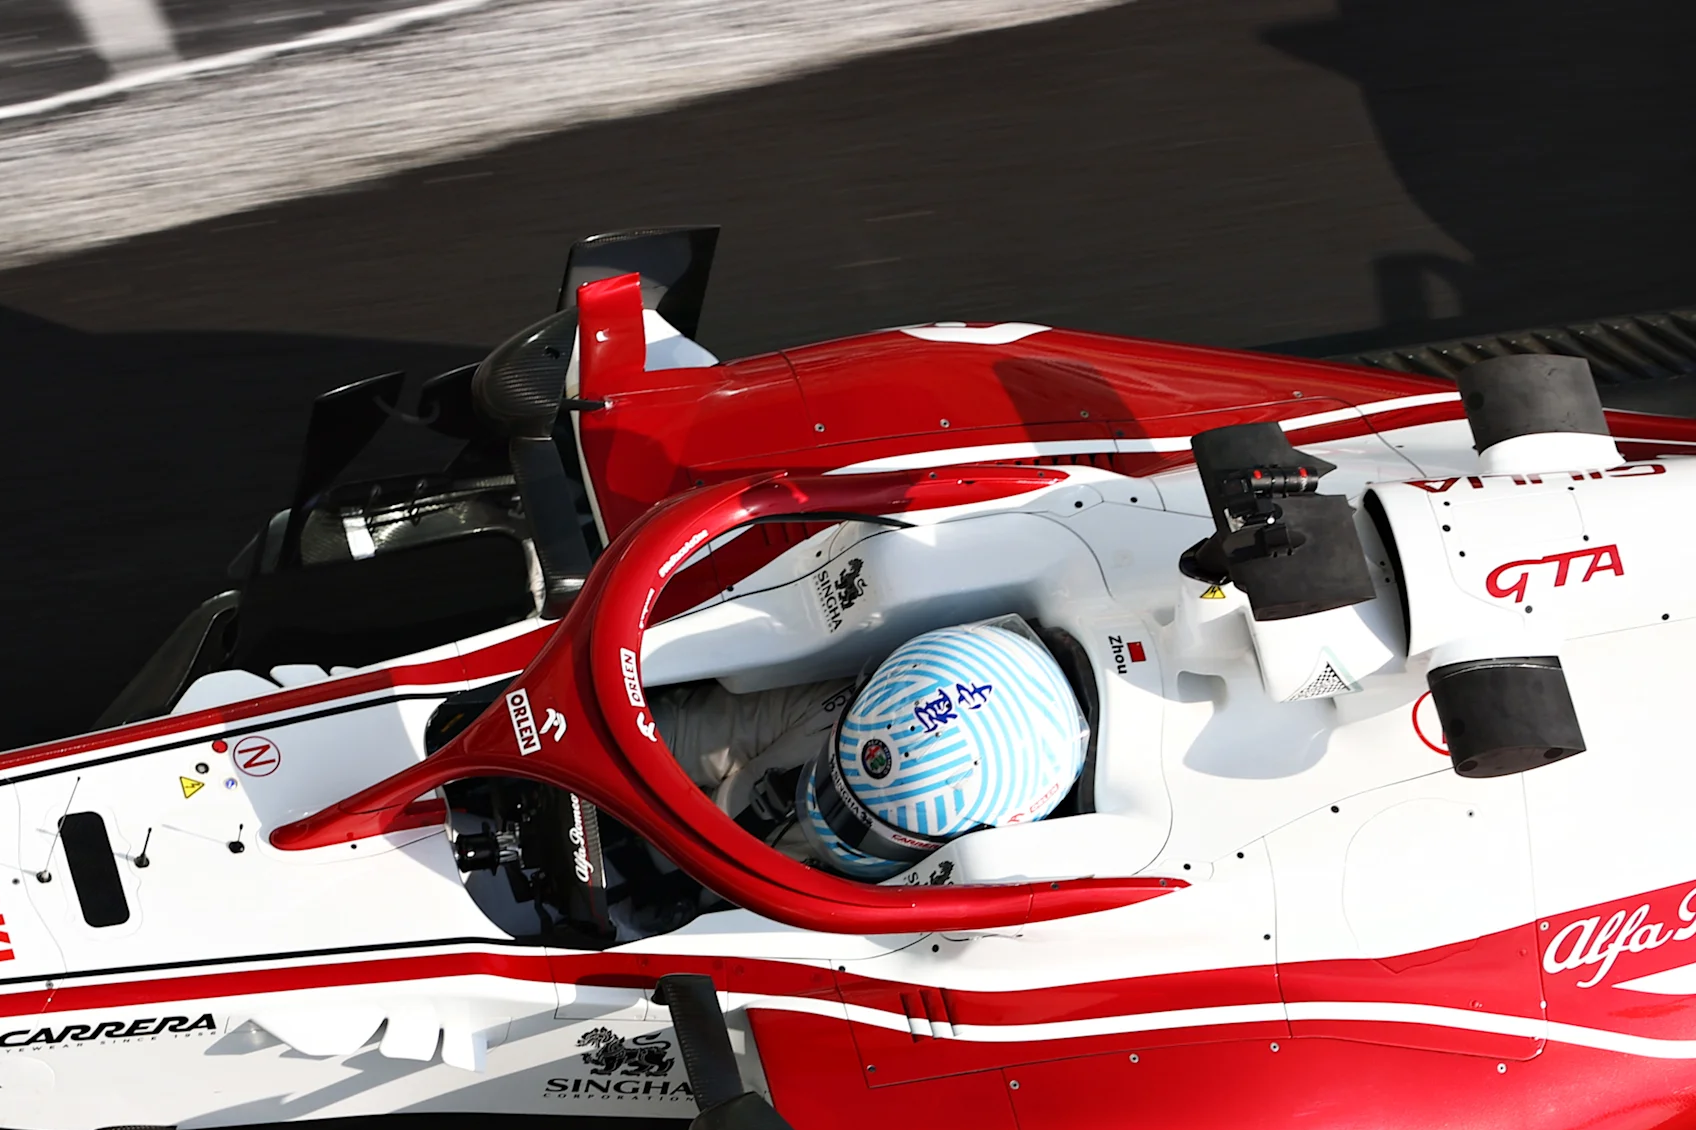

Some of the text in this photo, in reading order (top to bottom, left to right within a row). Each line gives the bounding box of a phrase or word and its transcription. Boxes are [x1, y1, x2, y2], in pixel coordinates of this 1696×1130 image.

[1486, 544, 1625, 604] GTA
[817, 570, 843, 630] SINGHA
[623, 653, 641, 704] ORLEN
[1108, 635, 1128, 674] Zhou
[509, 692, 537, 752] ORLEN
[238, 744, 276, 769] N
[569, 792, 595, 883] Alfa Romeo
[1542, 903, 1674, 989] Alfa
[100, 1036, 157, 1046] SINCE
[543, 1093, 694, 1102] CORPORATION
[545, 1078, 694, 1095] SINGHA
